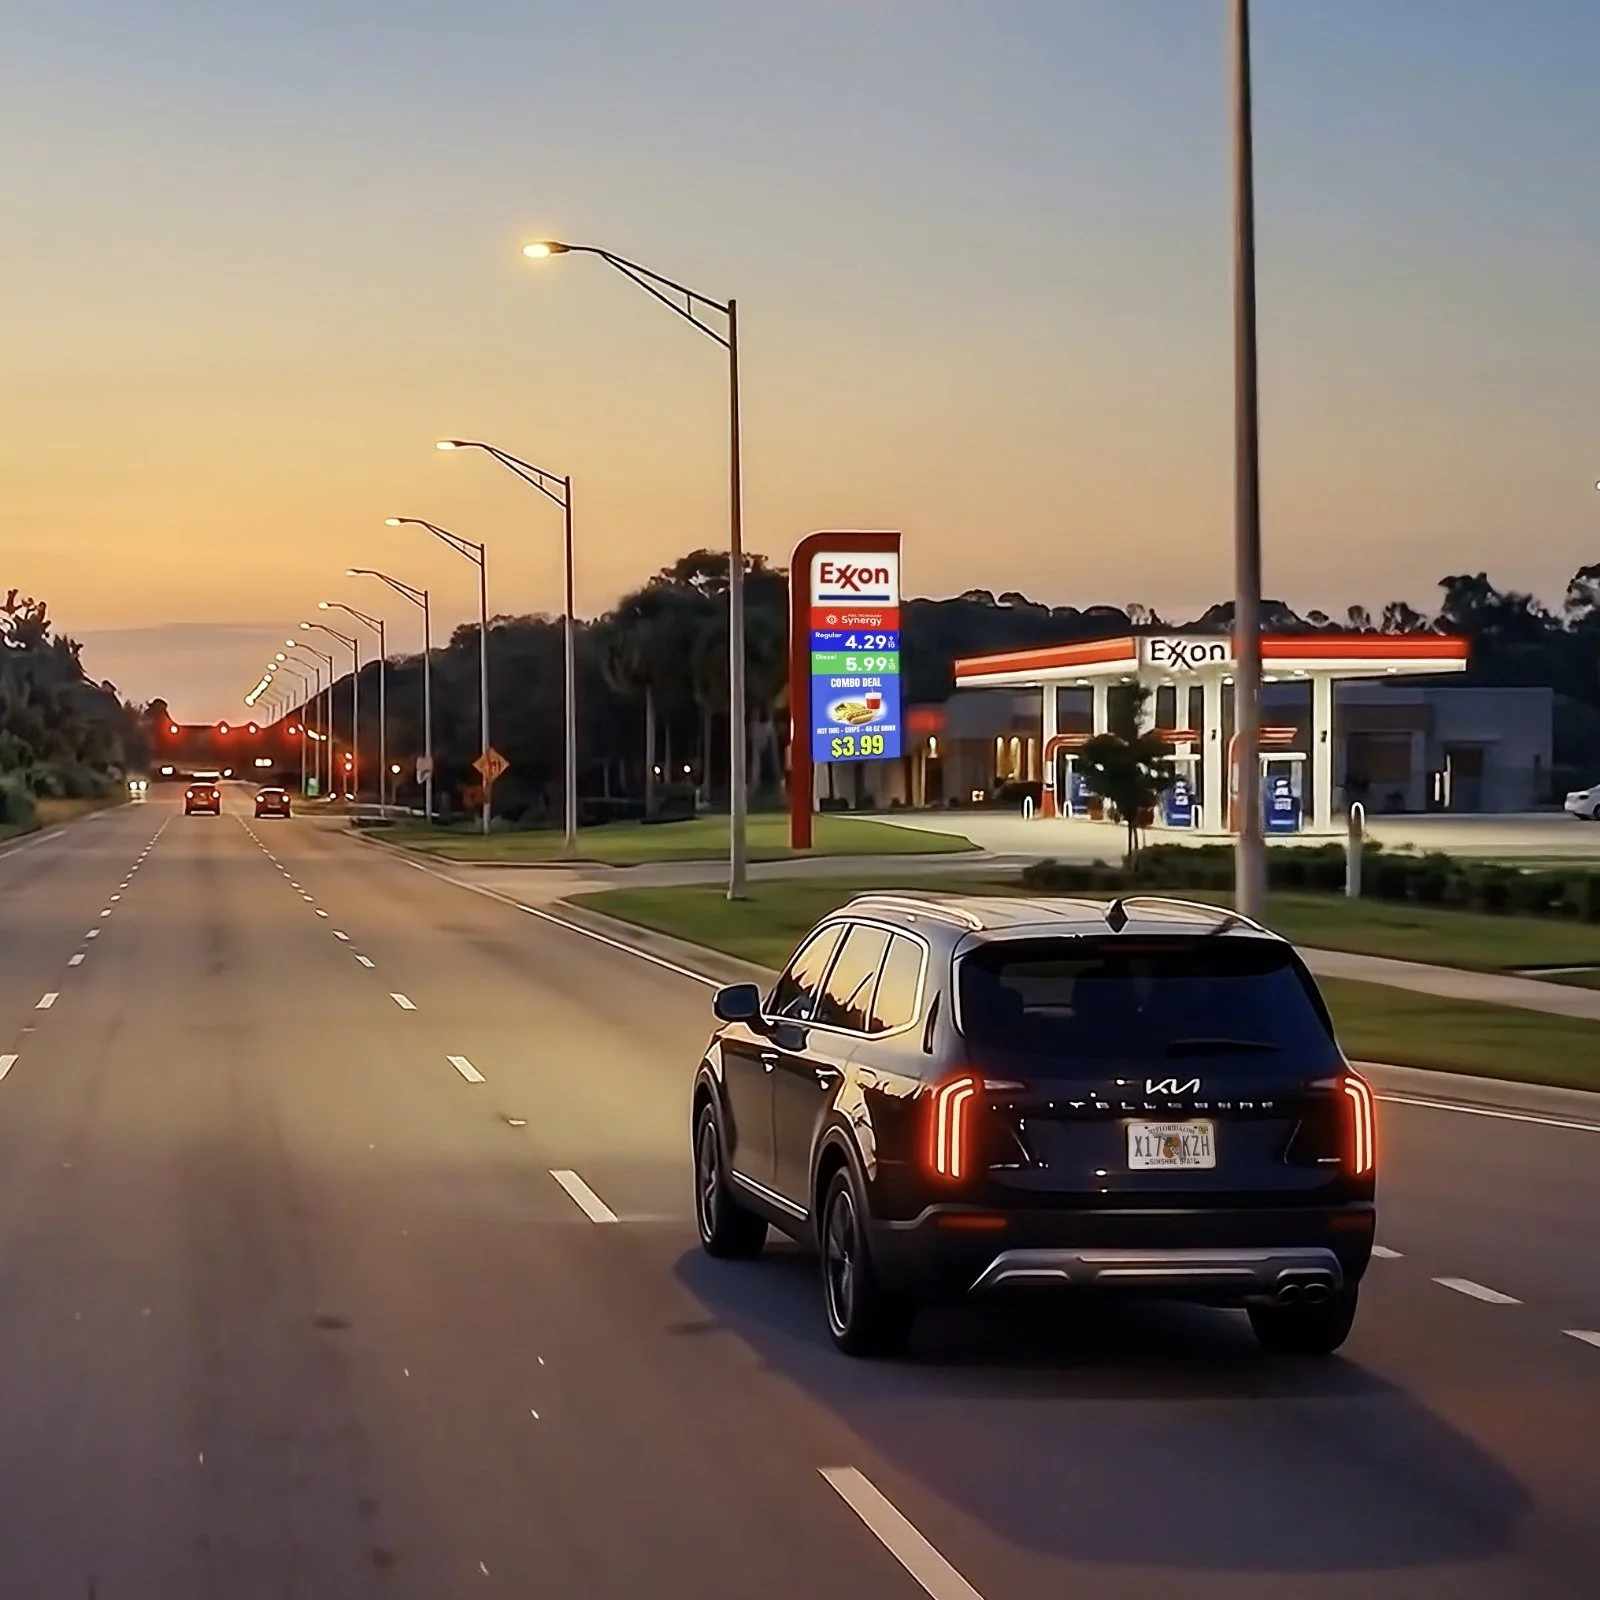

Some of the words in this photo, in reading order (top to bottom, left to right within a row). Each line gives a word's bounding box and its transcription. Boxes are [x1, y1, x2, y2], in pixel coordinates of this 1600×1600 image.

[820, 562, 889, 592] Exxon
[841, 615, 882, 627] Synergy
[815, 632, 842, 640] Regular
[844, 634, 887, 650] 4.29
[1150, 639, 1225, 670] Exxon
[845, 656, 888, 672] 5.99
[830, 677, 861, 688] COMBO
[862, 677, 882, 687] DEAL
[816, 727, 827, 735] HOT
[844, 726, 860, 734] CHIPS
[831, 734, 884, 758] $3.99
[1181, 1135, 1210, 1157] KZH
